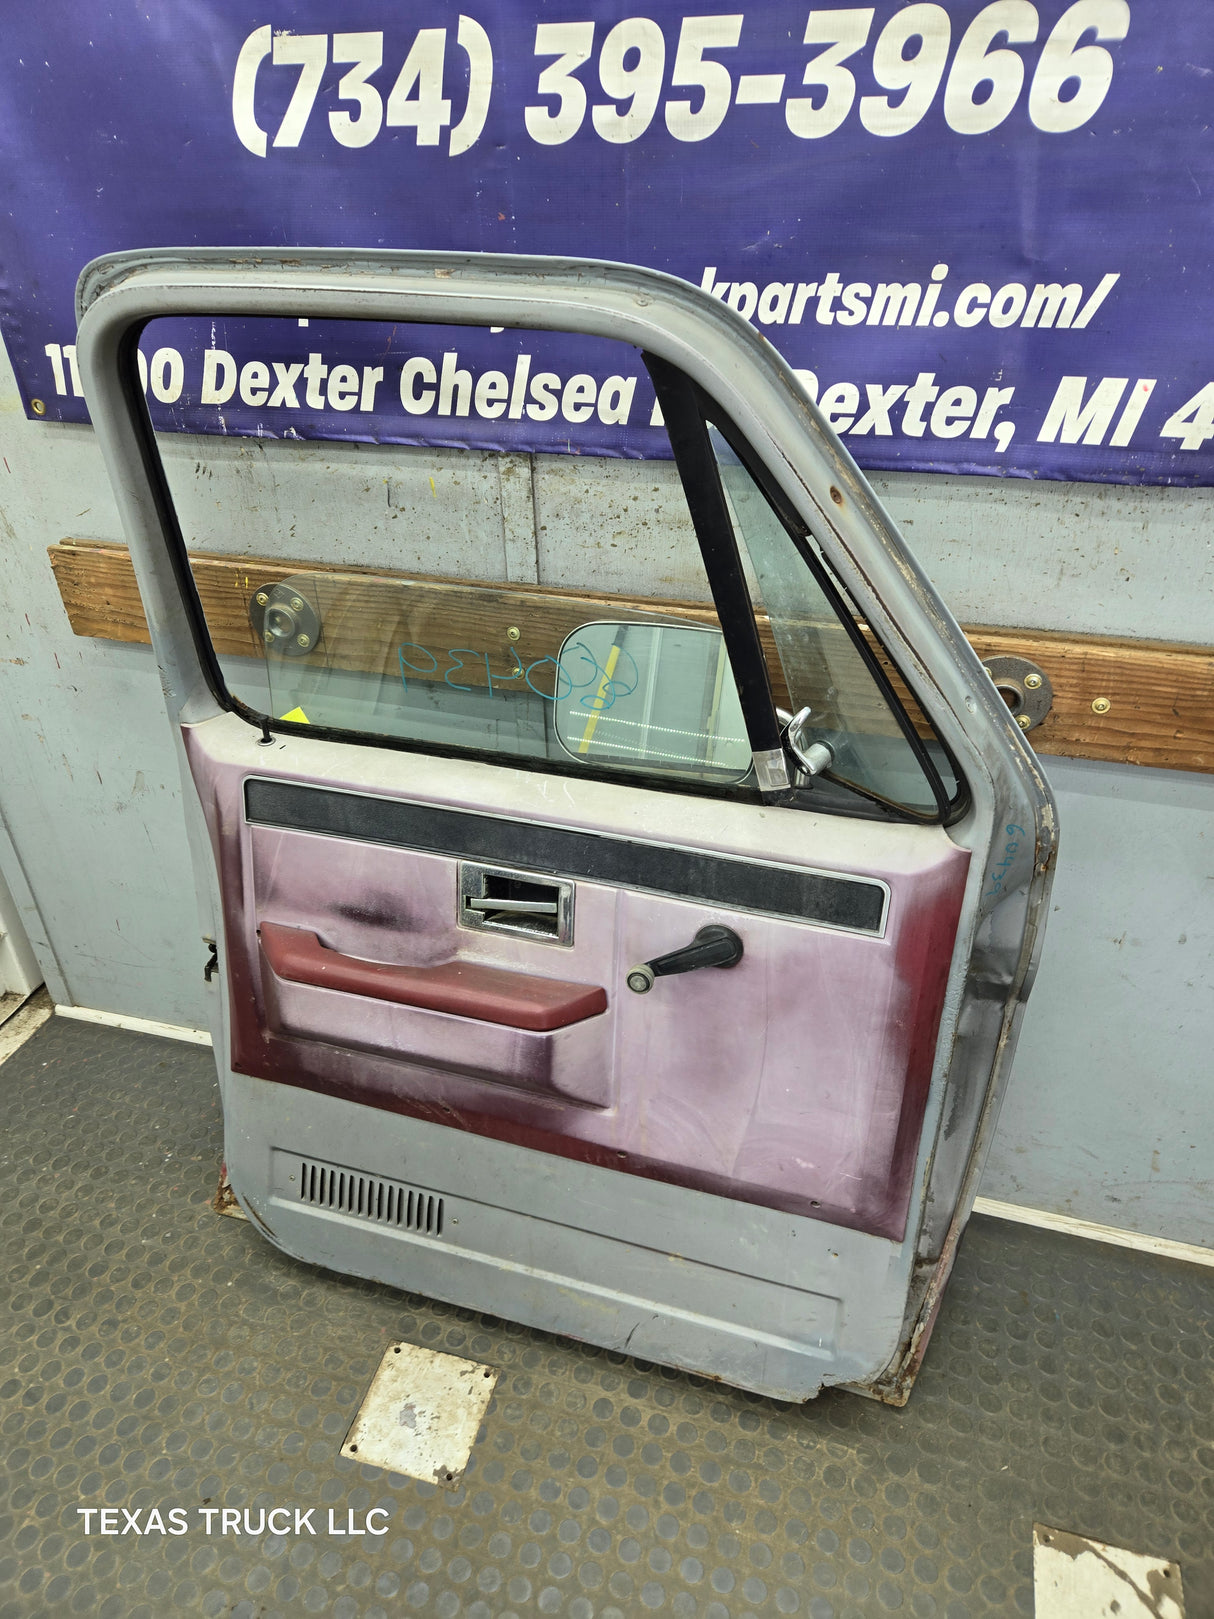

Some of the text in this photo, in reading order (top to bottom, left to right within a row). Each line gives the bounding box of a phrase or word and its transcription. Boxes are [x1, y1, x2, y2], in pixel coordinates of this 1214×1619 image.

[232, 0, 1130, 158] (734) 395-3966
[701, 263, 1121, 329] kpartsmi.com/
[44, 343, 185, 404] 110
[201, 349, 383, 412] Dexter
[399, 352, 637, 425] Chelsea
[1036, 376, 1158, 447] MI
[985, 823, 1026, 896] 60439
